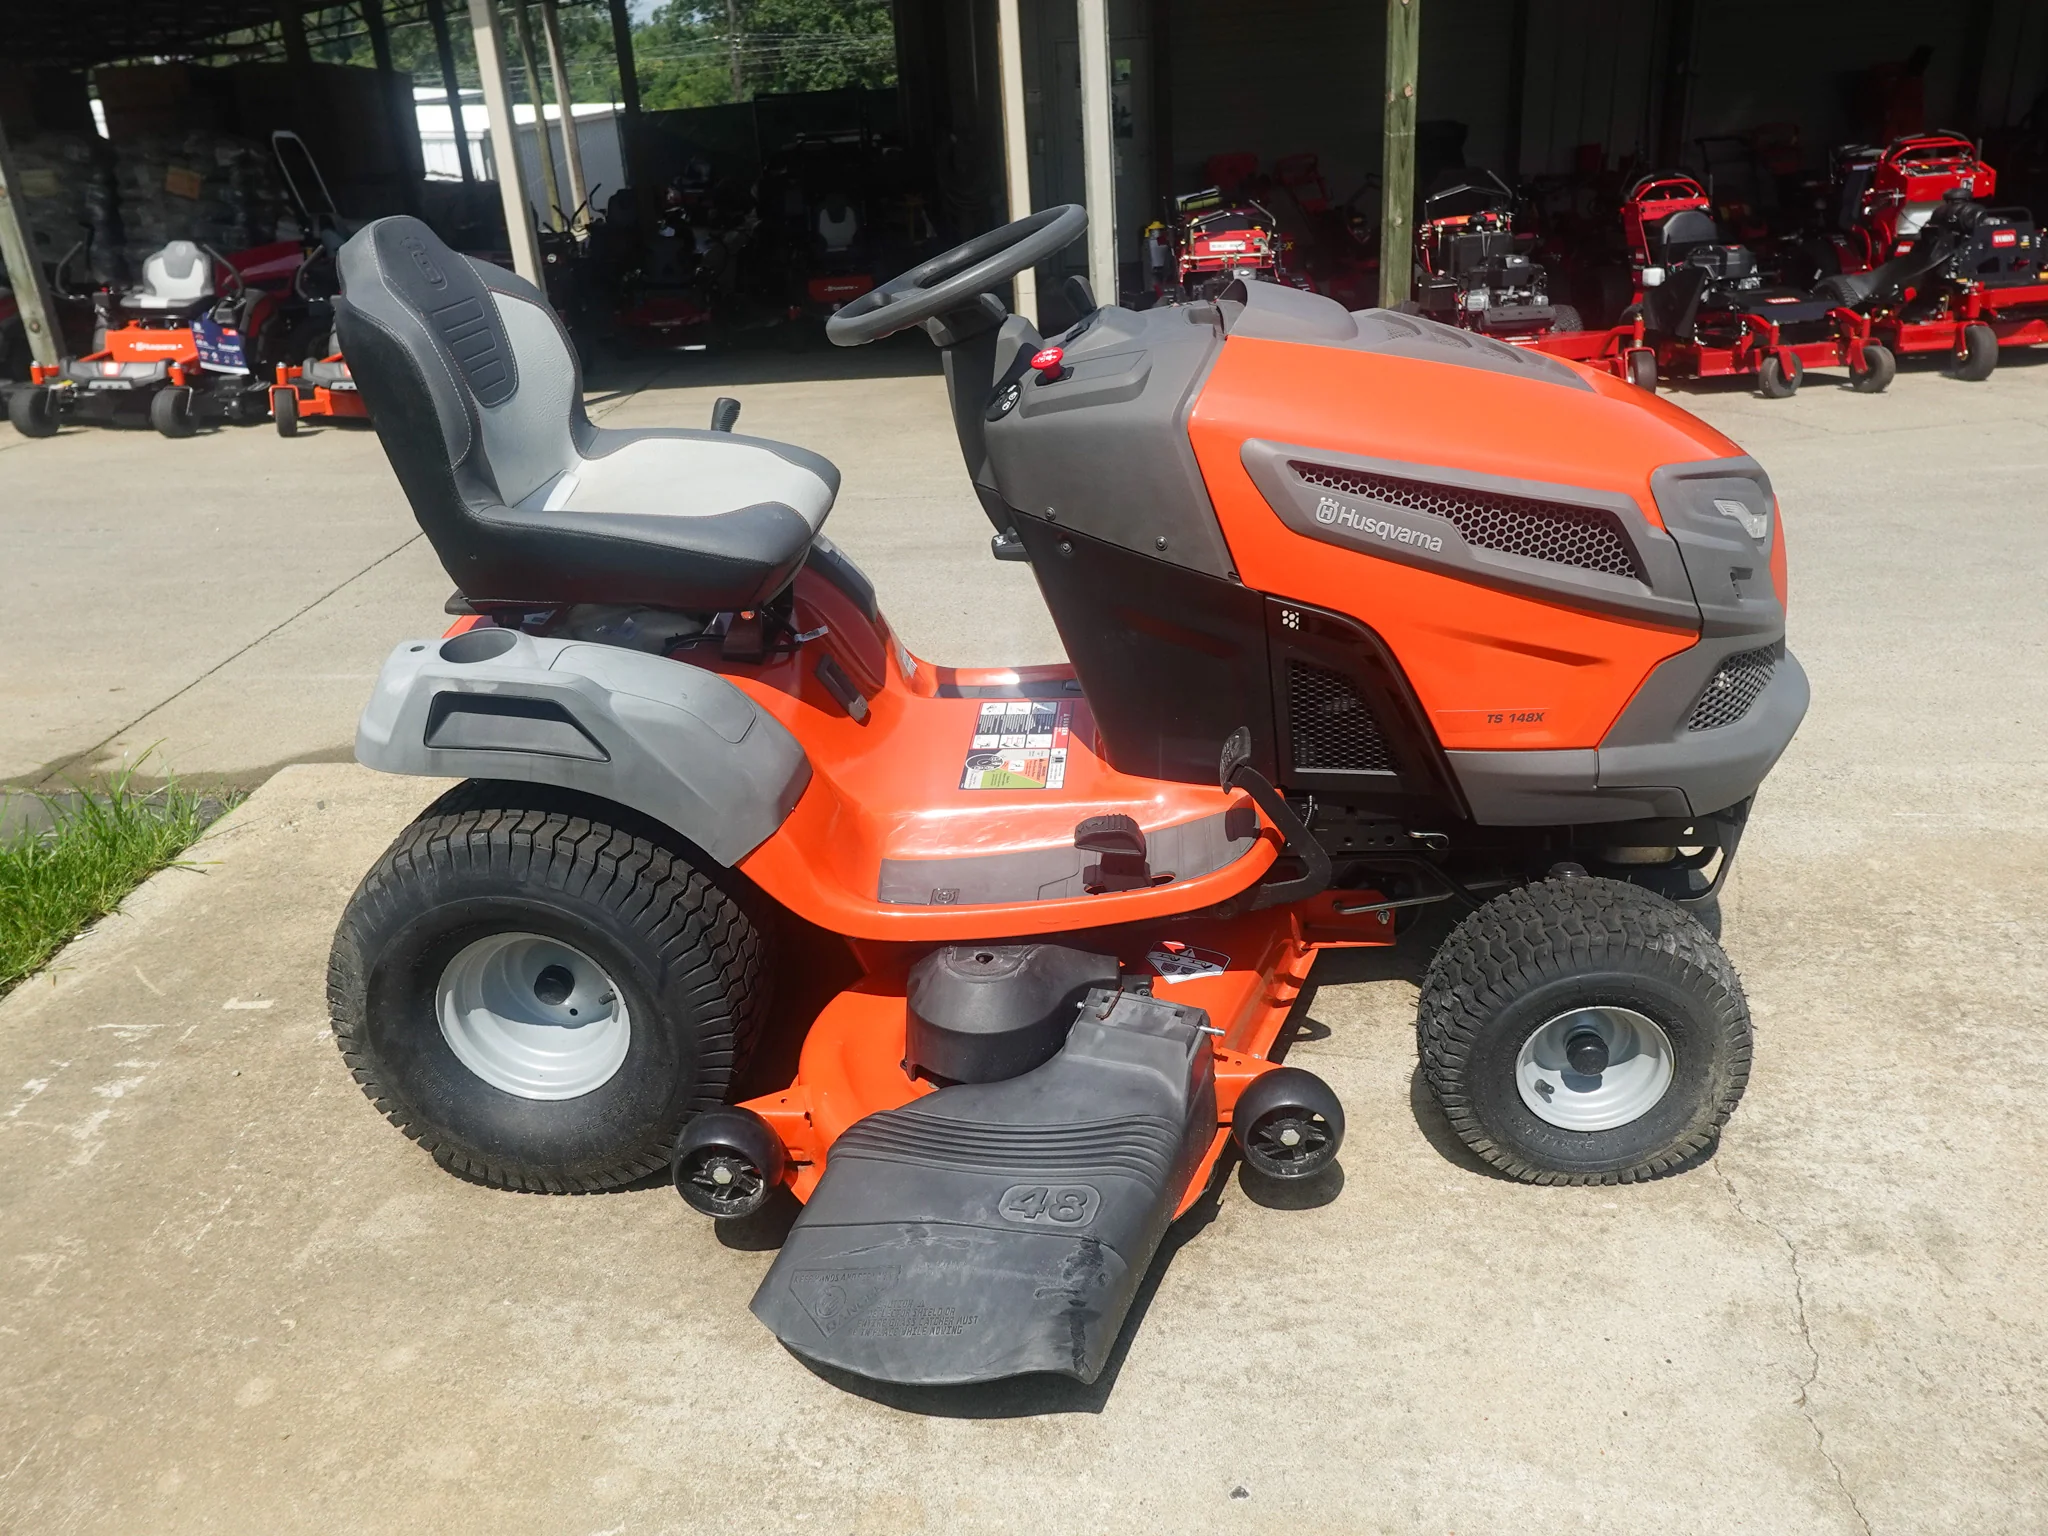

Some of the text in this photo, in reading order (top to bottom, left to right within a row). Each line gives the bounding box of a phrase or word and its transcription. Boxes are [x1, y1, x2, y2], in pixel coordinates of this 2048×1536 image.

[1337, 506, 1442, 552] Husqvarna
[1487, 712, 1544, 724] TS 148X
[1009, 1187, 1088, 1222] 48
[913, 1308, 943, 1317] SHIELD
[944, 1307, 956, 1316] OR
[919, 1316, 955, 1326] CATCHER
[956, 1315, 979, 1325] MUST
